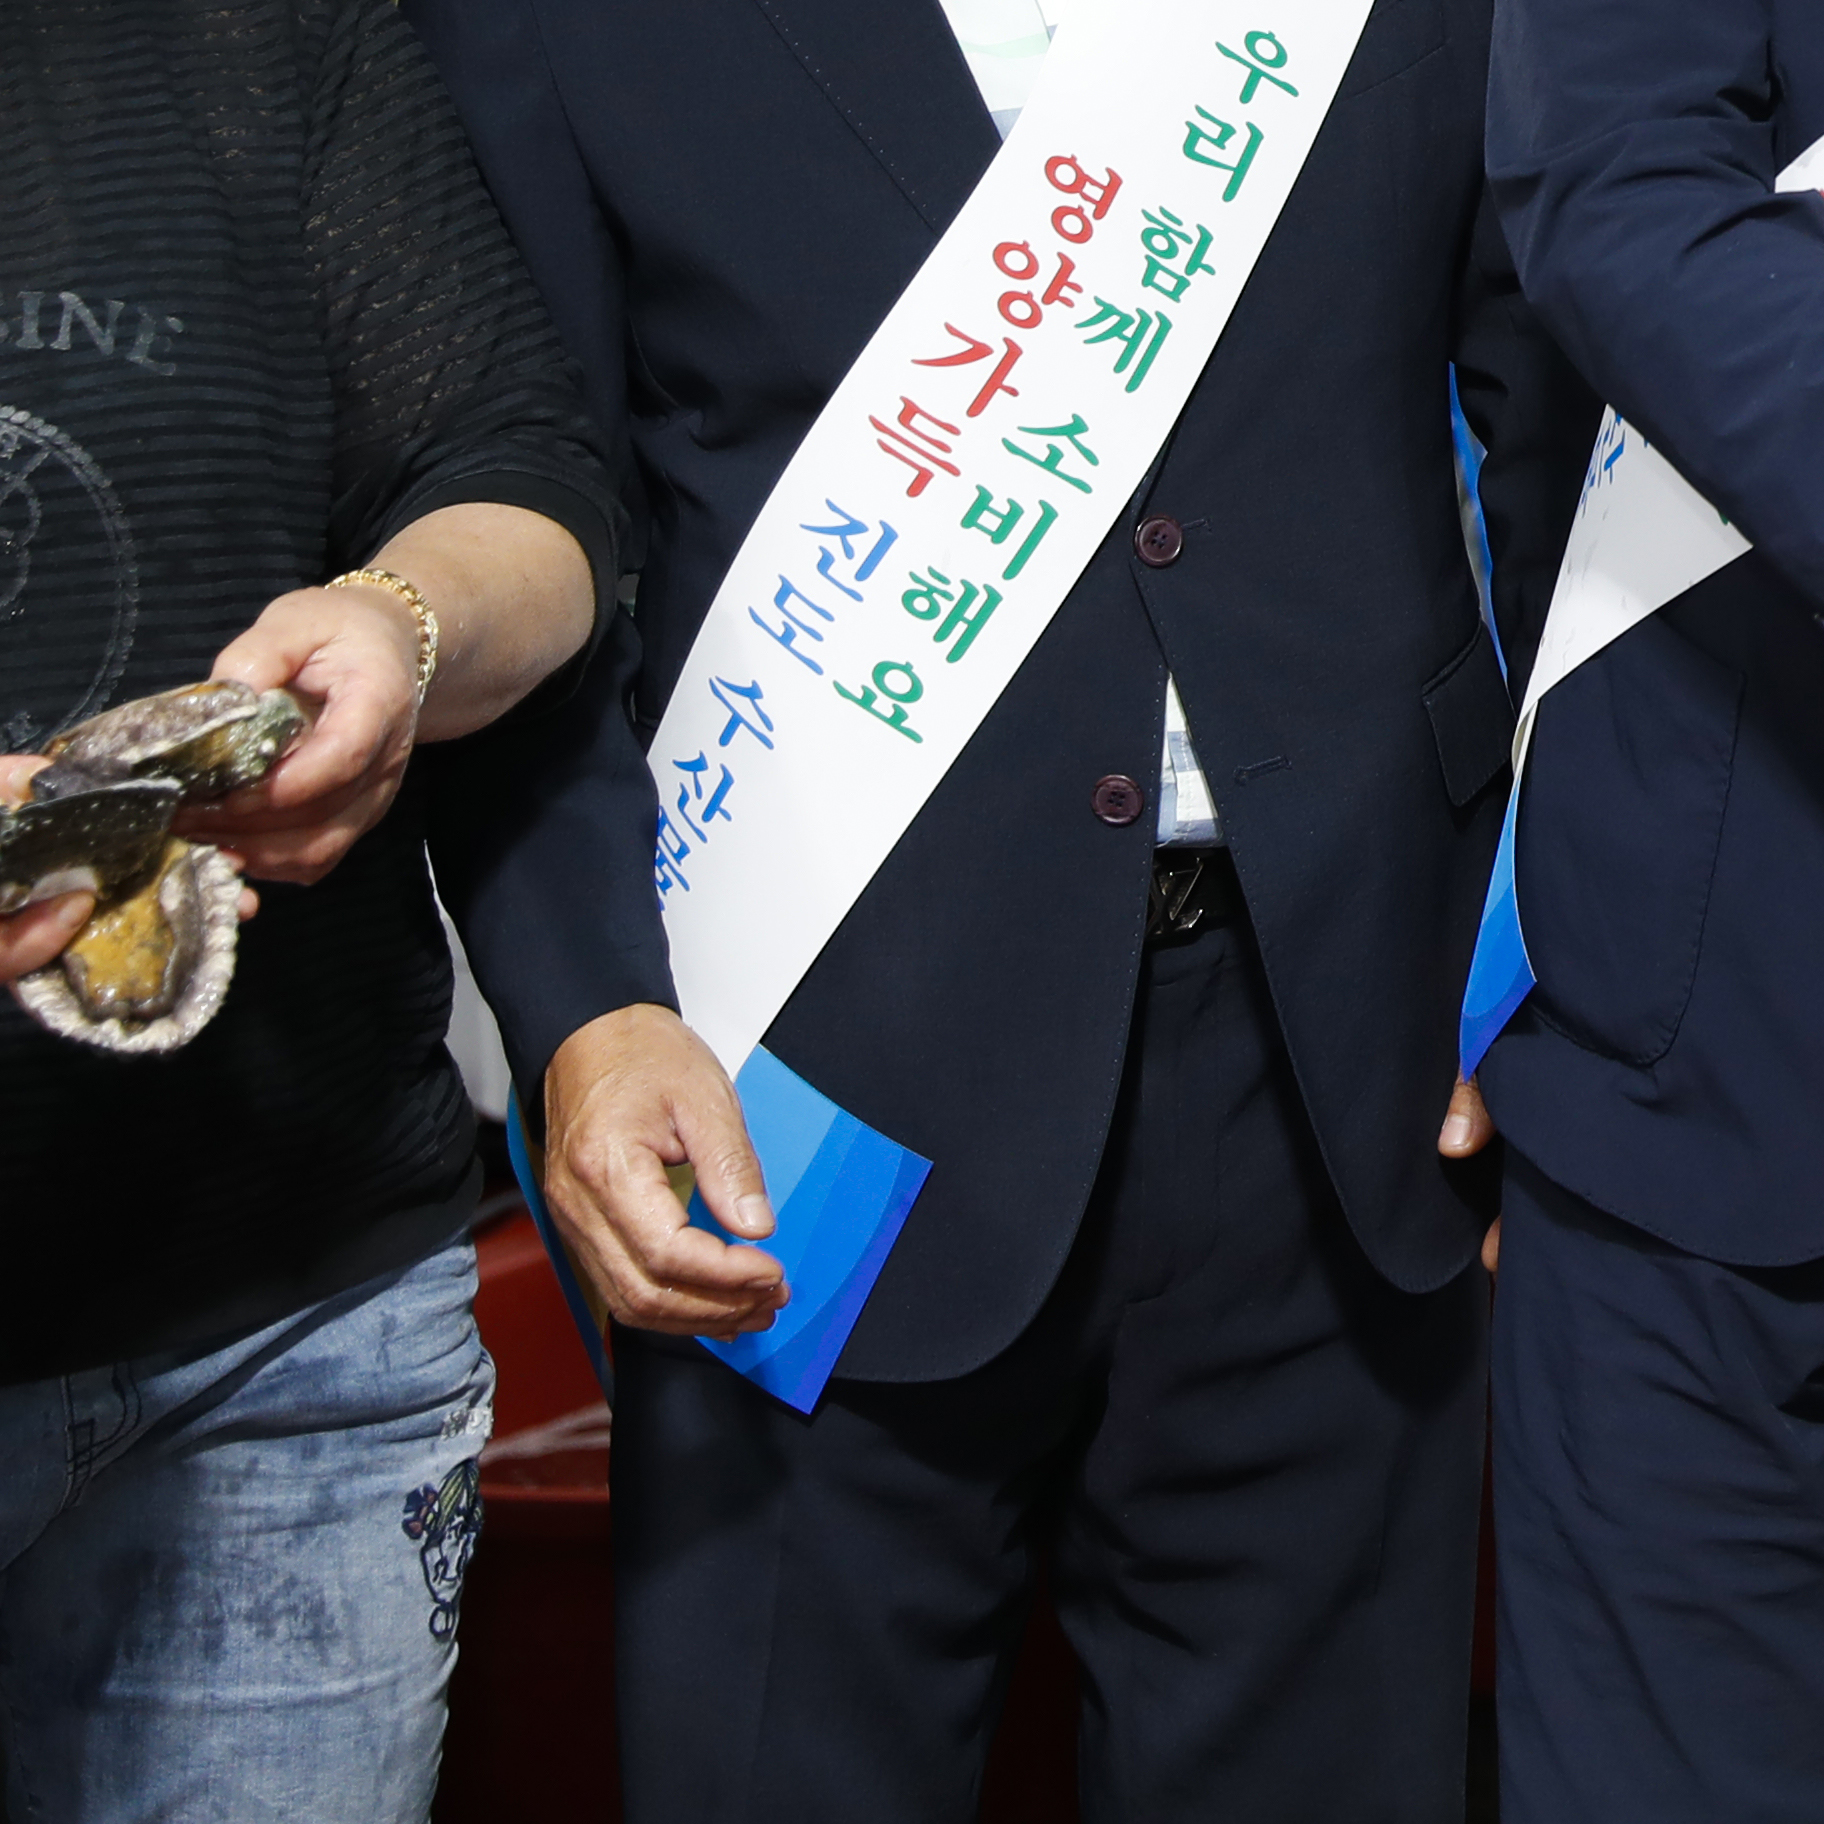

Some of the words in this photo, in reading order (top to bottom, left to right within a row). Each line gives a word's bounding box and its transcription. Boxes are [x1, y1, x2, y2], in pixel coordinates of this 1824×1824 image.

[1183, 30, 1299, 202] 우리
[0, 288, 184, 376] INE
[869, 153, 1123, 498] 영양가득
[1074, 206, 1216, 393] 함께
[749, 498, 899, 676] 진도
[833, 414, 1099, 744] 소비해요
